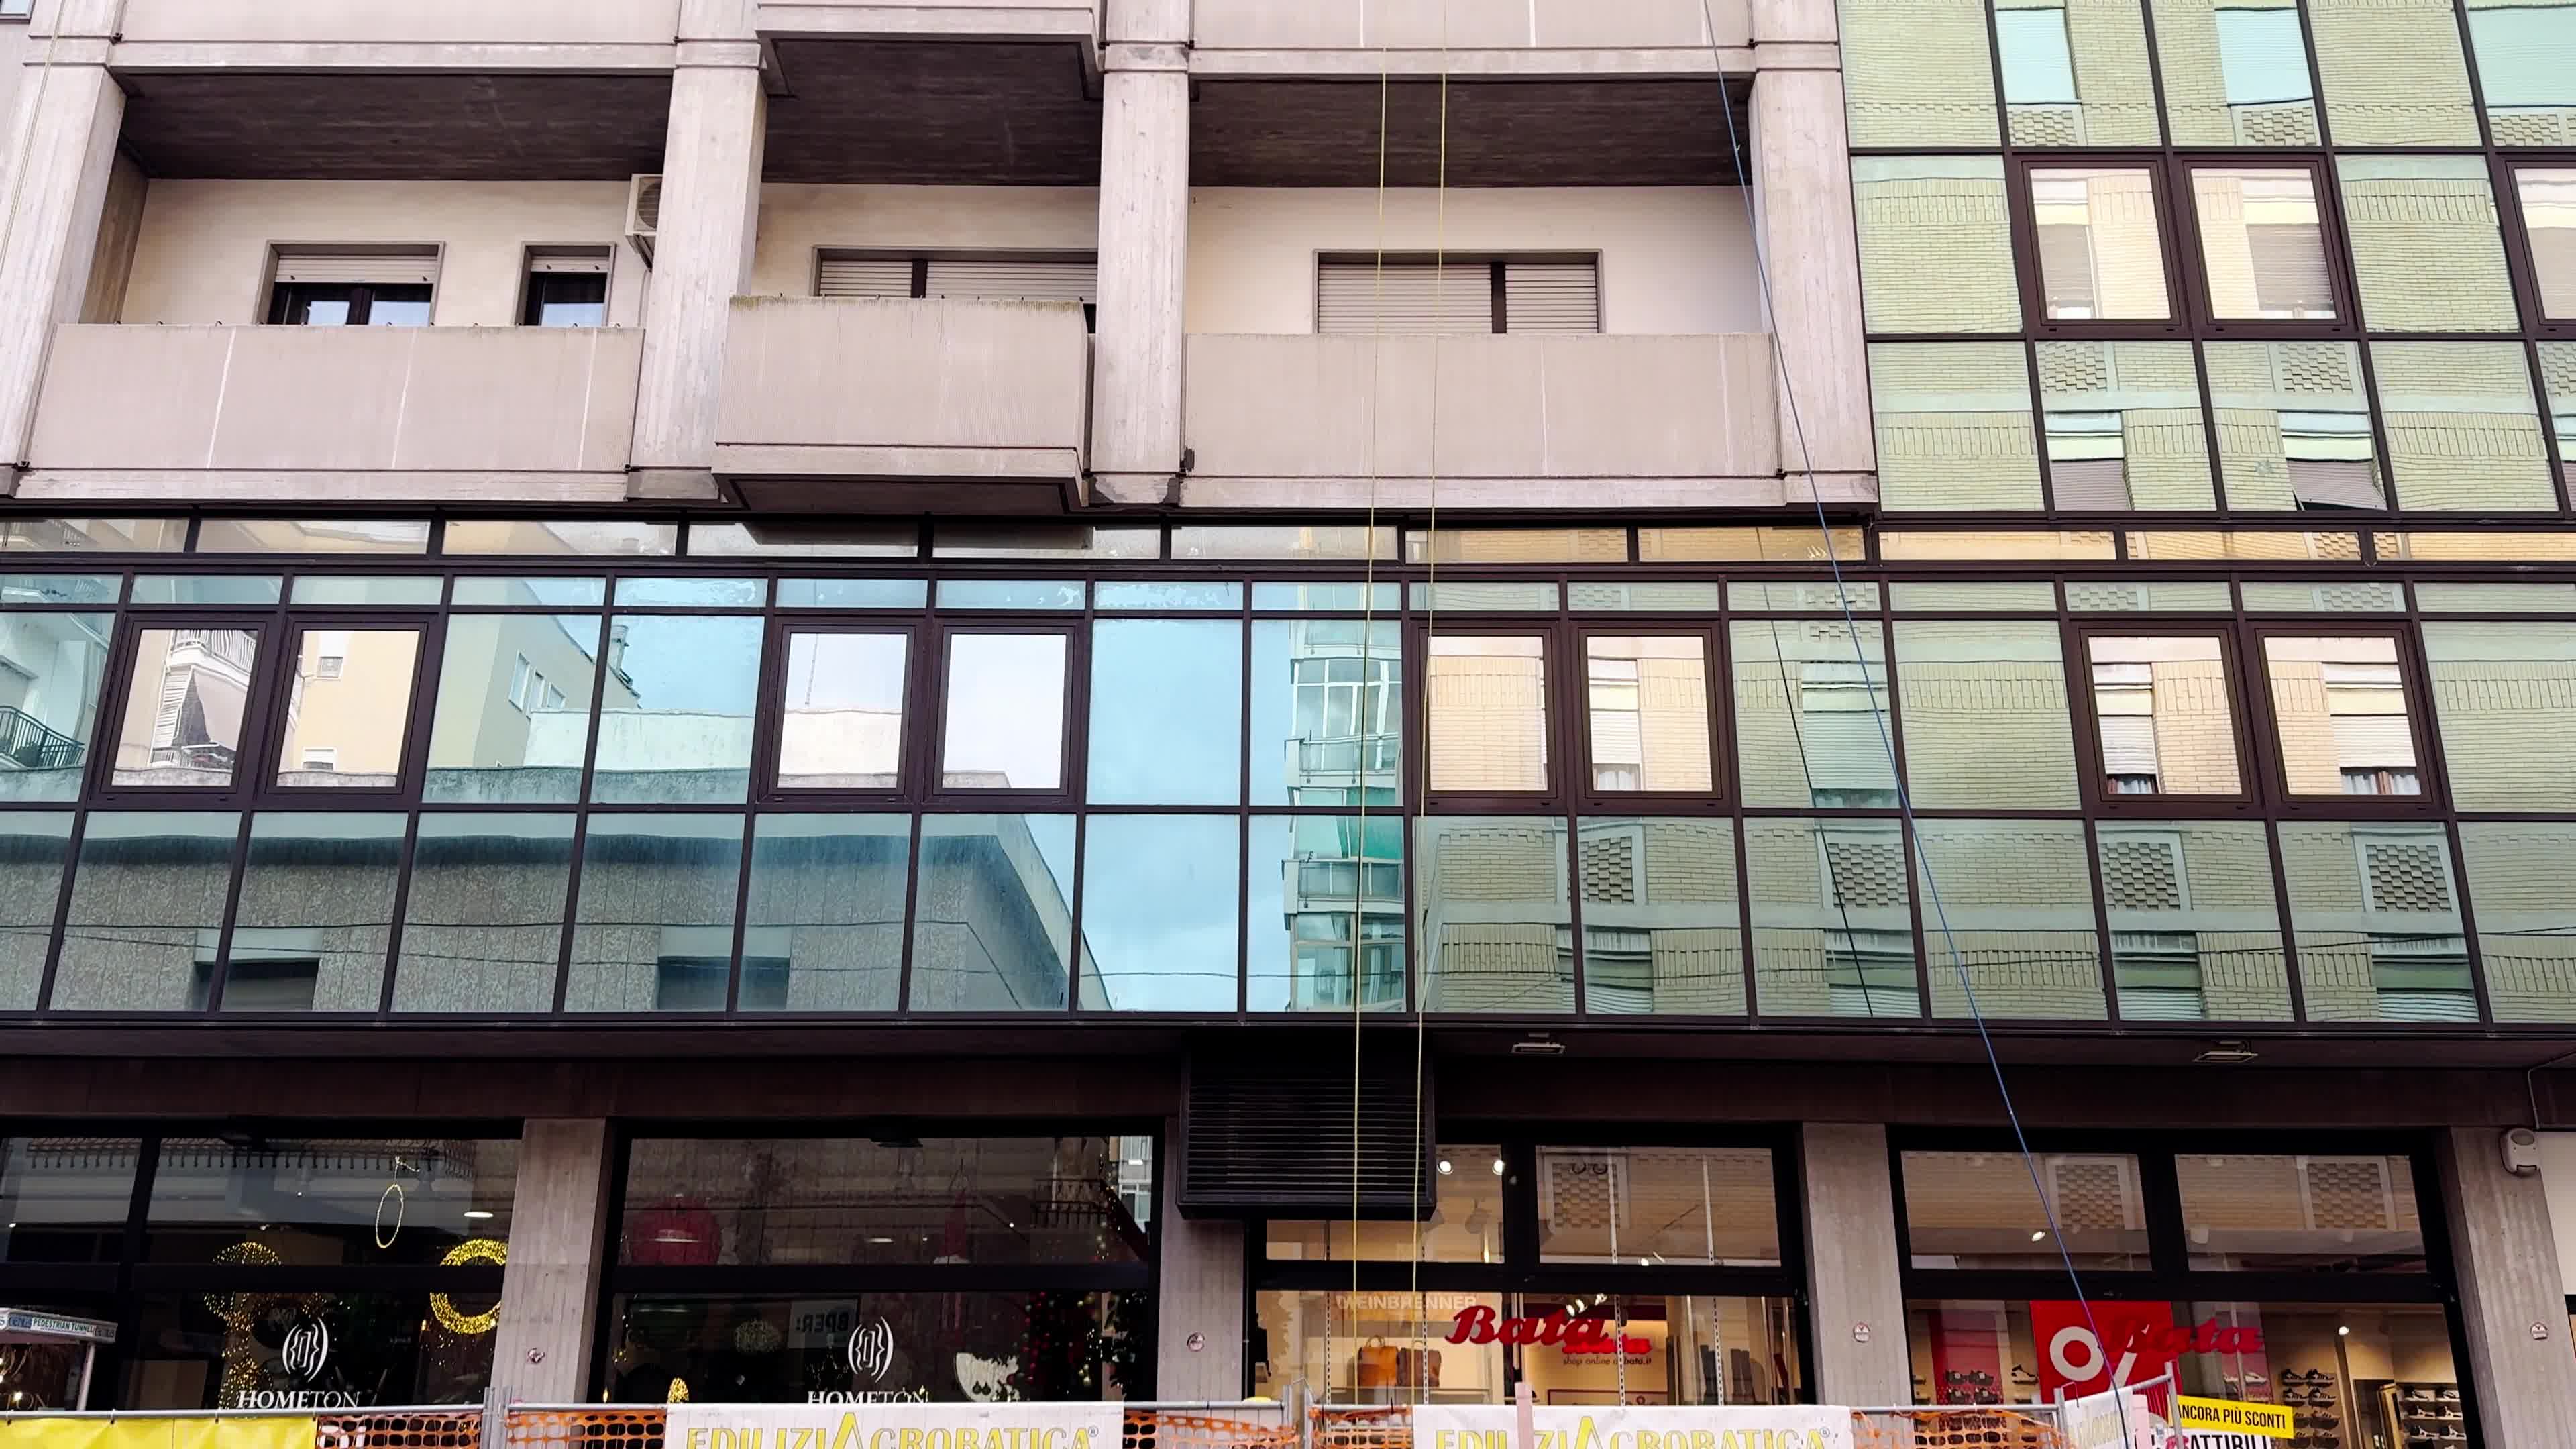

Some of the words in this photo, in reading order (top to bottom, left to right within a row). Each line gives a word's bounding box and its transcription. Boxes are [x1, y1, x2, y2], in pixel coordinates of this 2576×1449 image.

[1444, 1305, 1609, 1345] Bata
[1585, 1355, 1610, 1365] online
[237, 1390, 360, 1409] HOMETON
[2223, 1406, 2241, 1424] PIÙ
[2245, 1411, 2286, 1429] SCONTI
